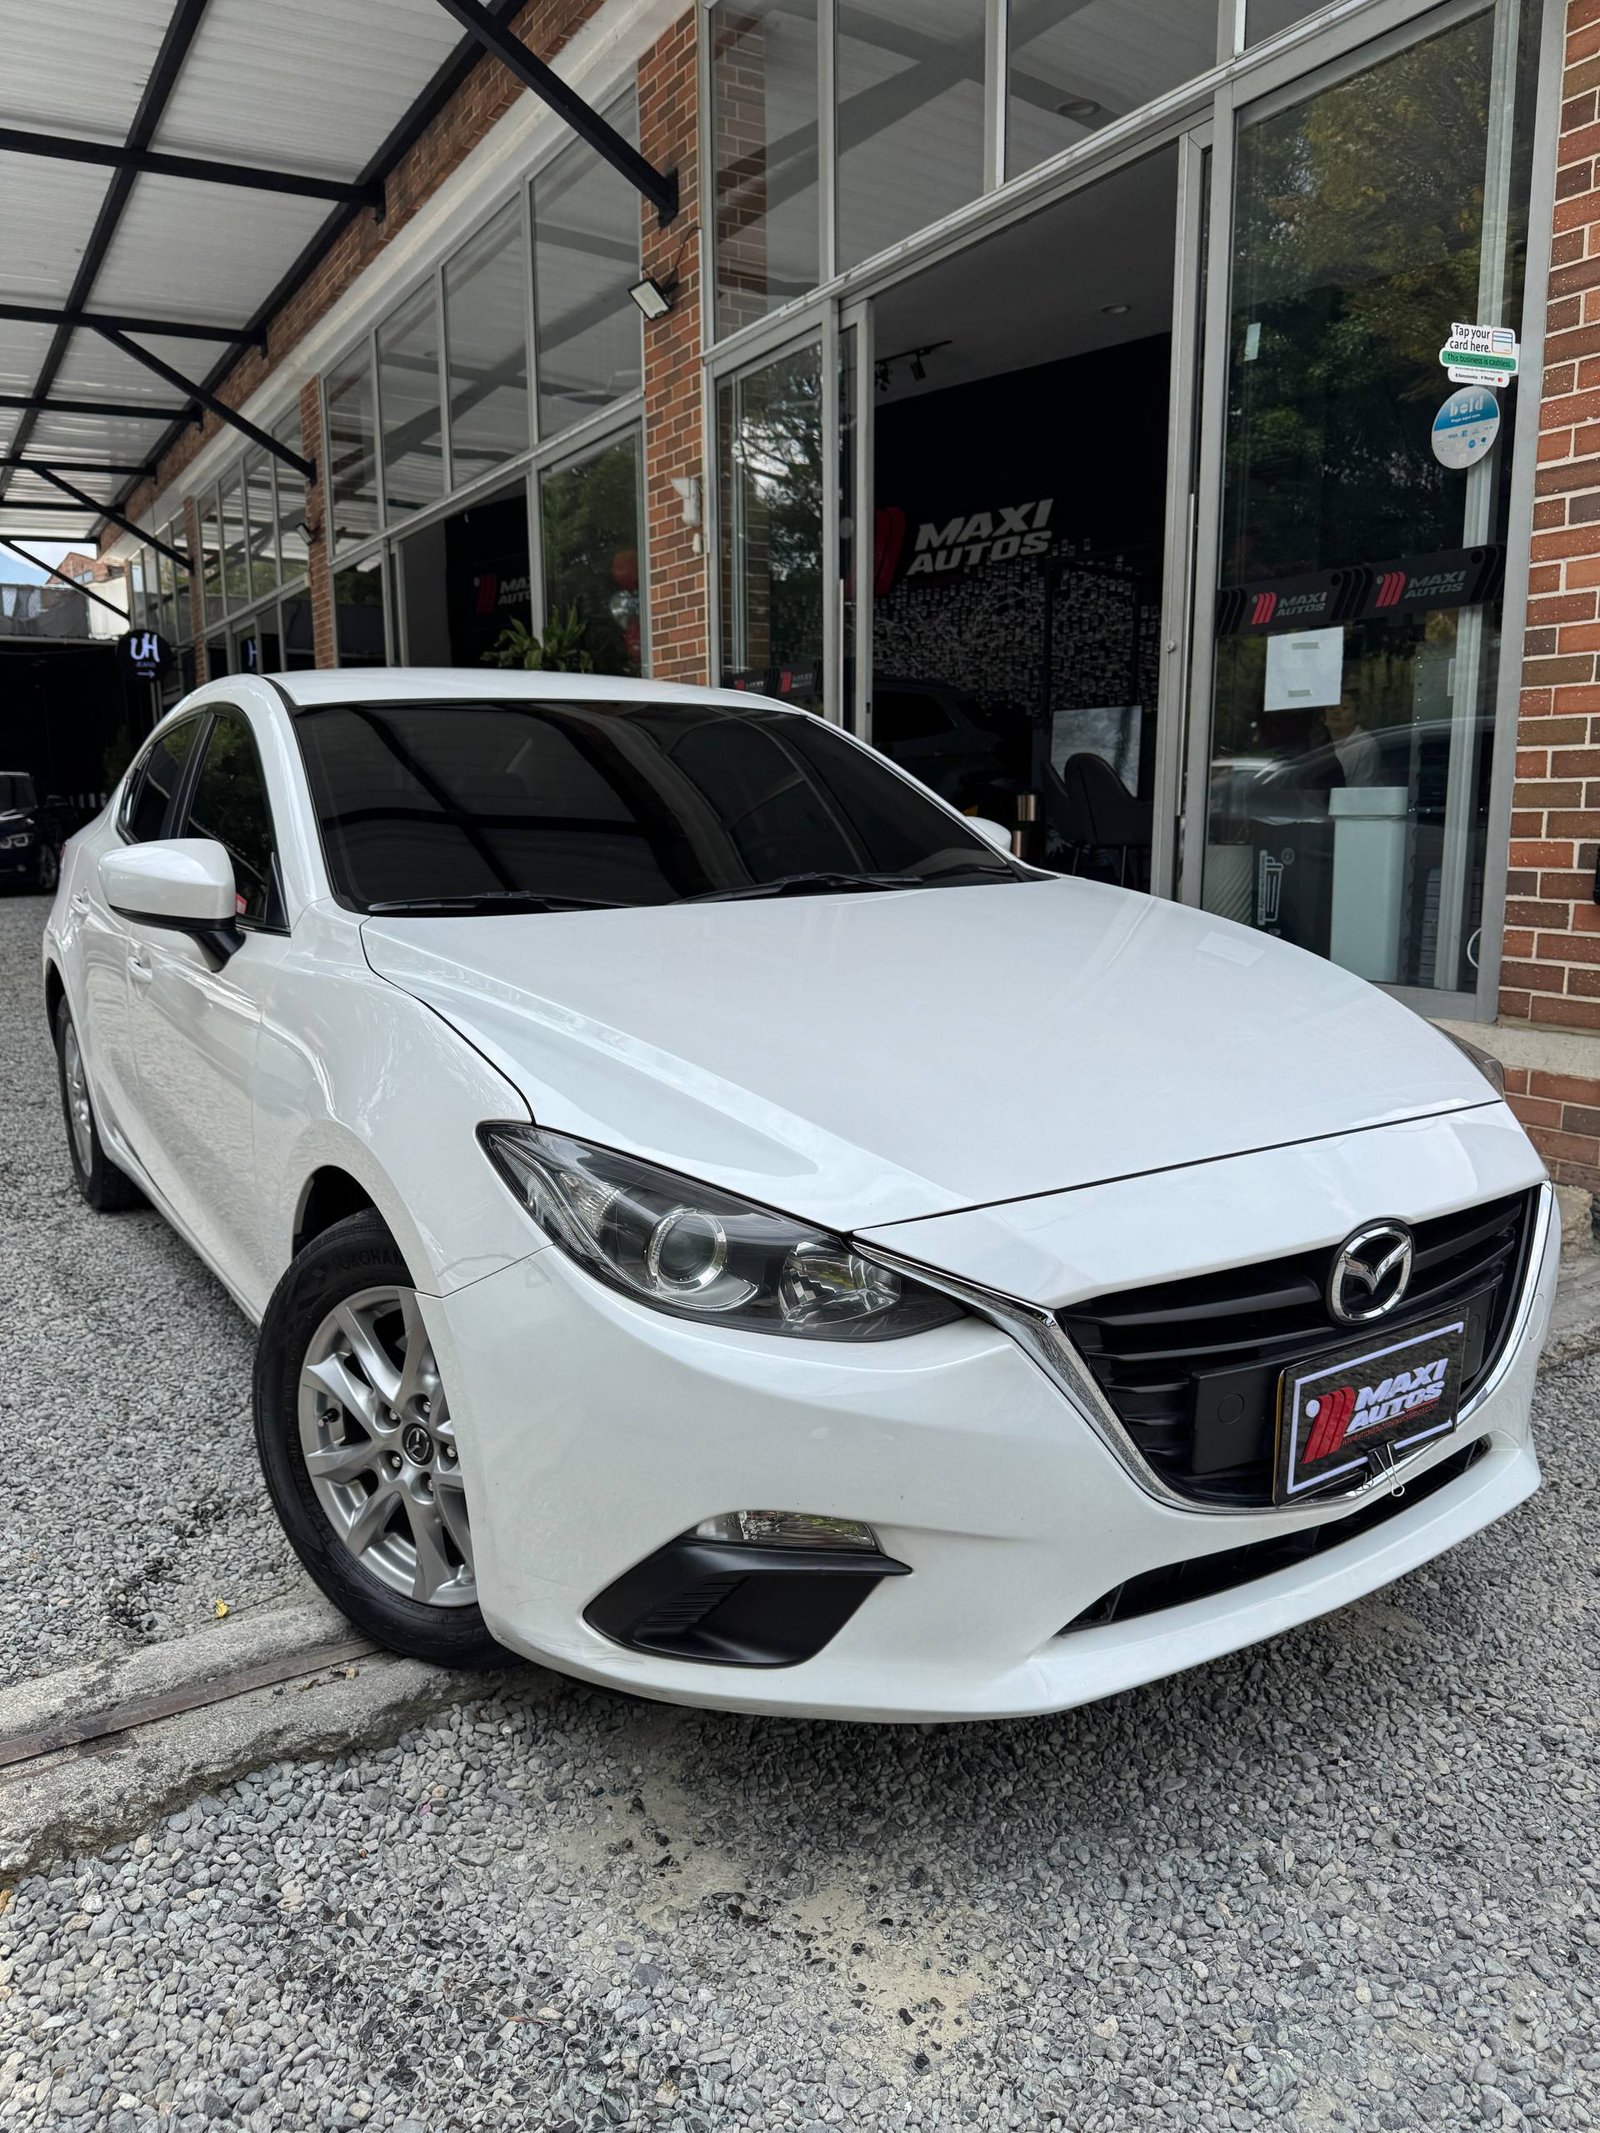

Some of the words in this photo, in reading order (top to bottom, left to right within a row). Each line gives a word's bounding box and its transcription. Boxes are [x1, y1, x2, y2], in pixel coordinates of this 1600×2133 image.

[1455, 325, 1469, 339] Tap
[1471, 328, 1490, 340] your
[1450, 340, 1468, 351] card
[1470, 341, 1491, 354] here.
[1447, 353, 1459, 362] This
[1460, 355, 1482, 364] business
[1450, 395, 1483, 416] bold
[914, 498, 1054, 551] MAXI
[906, 530, 1053, 576] AUTOS
[1408, 570, 1467, 589] MAXI
[1404, 582, 1465, 599] AUTOS
[1278, 591, 1328, 609] MAXI
[1276, 602, 1327, 617] AUTOS
[1355, 1358, 1448, 1411] MAXI
[1346, 1381, 1445, 1433] AUTOS
